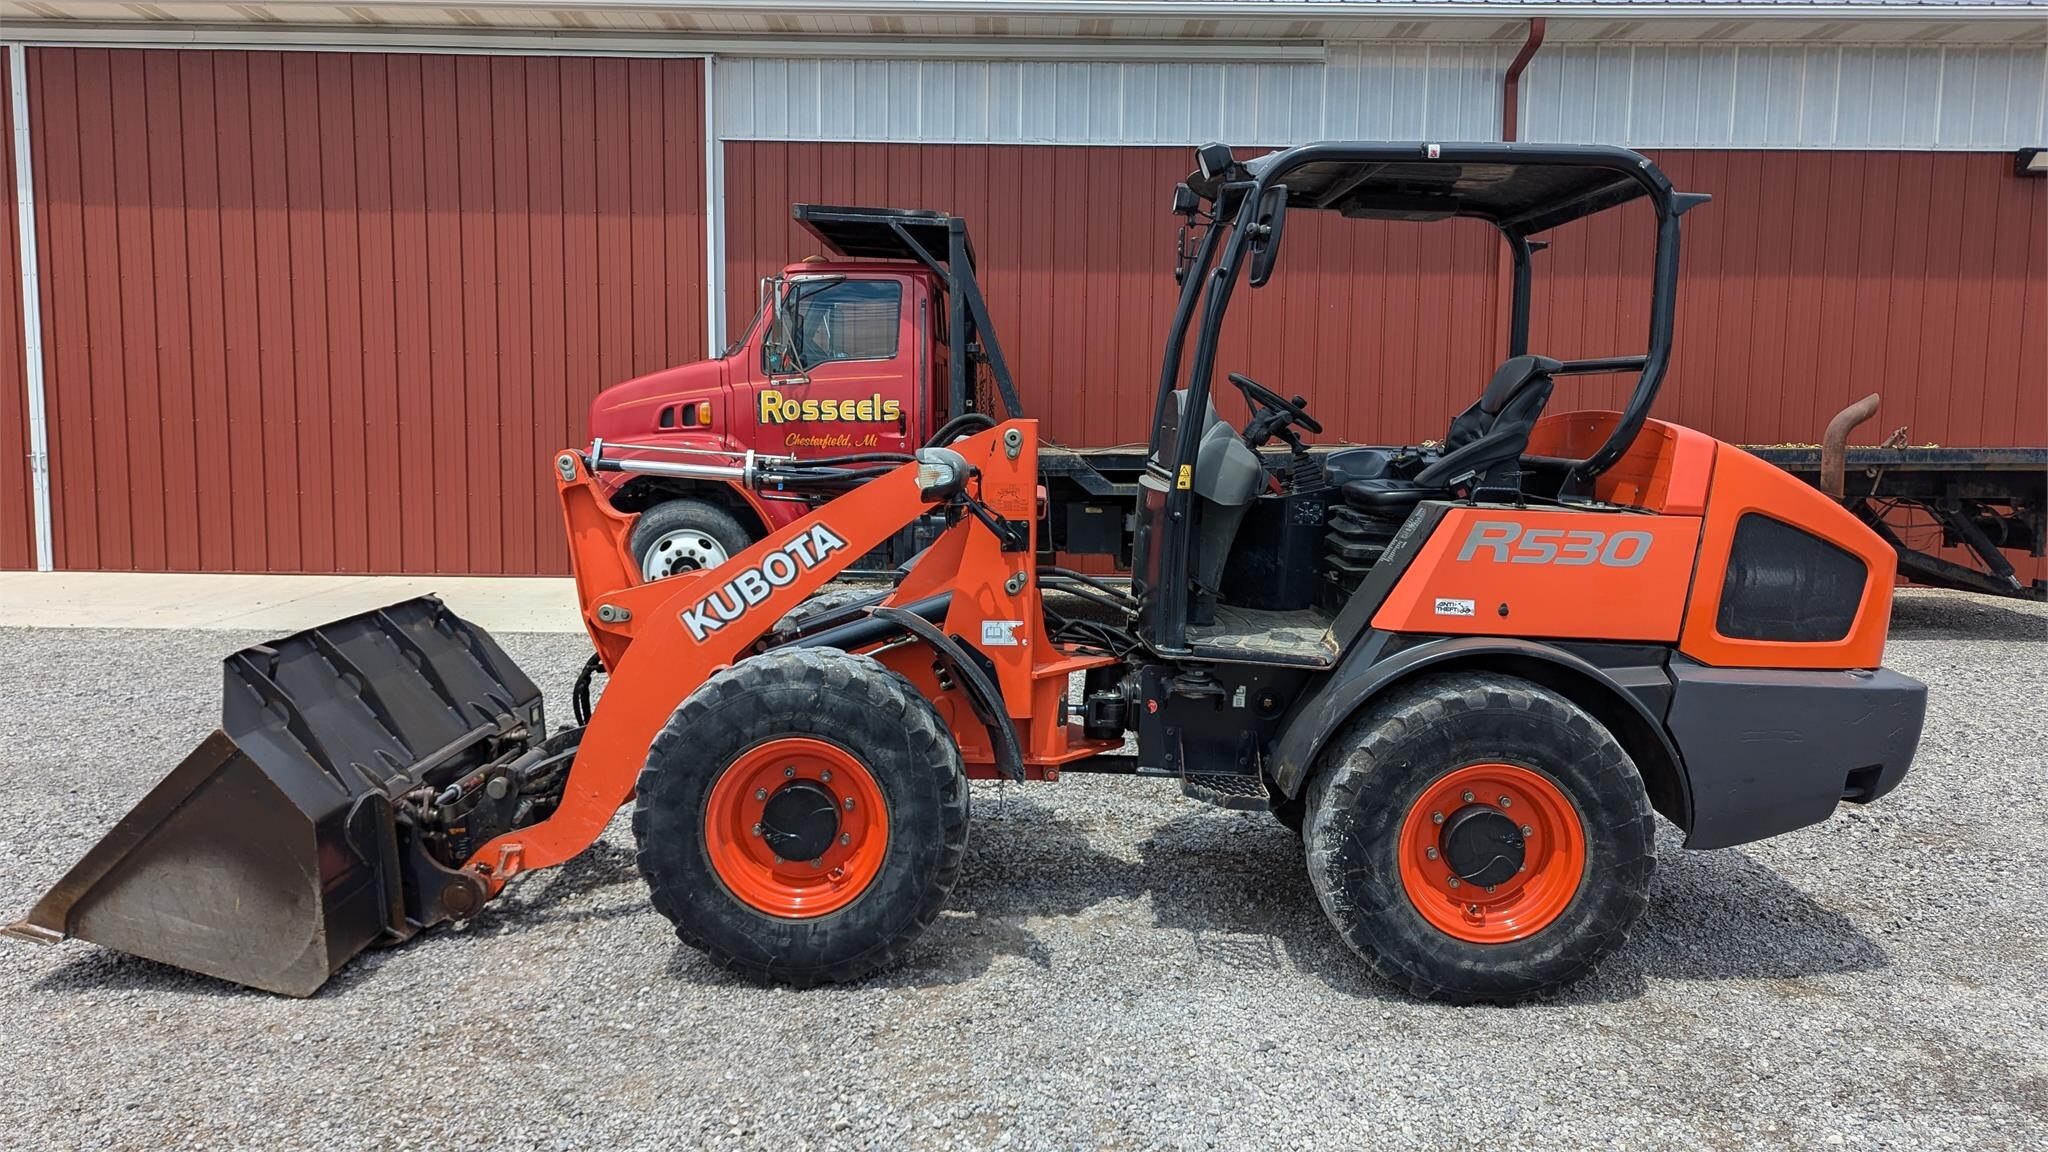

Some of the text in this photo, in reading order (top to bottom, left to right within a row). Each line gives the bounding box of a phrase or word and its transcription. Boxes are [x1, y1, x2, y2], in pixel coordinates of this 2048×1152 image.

[759, 389, 901, 424] Rosseels
[785, 433, 878, 449] Chesterfield, Mi
[1456, 520, 1654, 567] R530
[681, 524, 846, 641] KUBOTA
